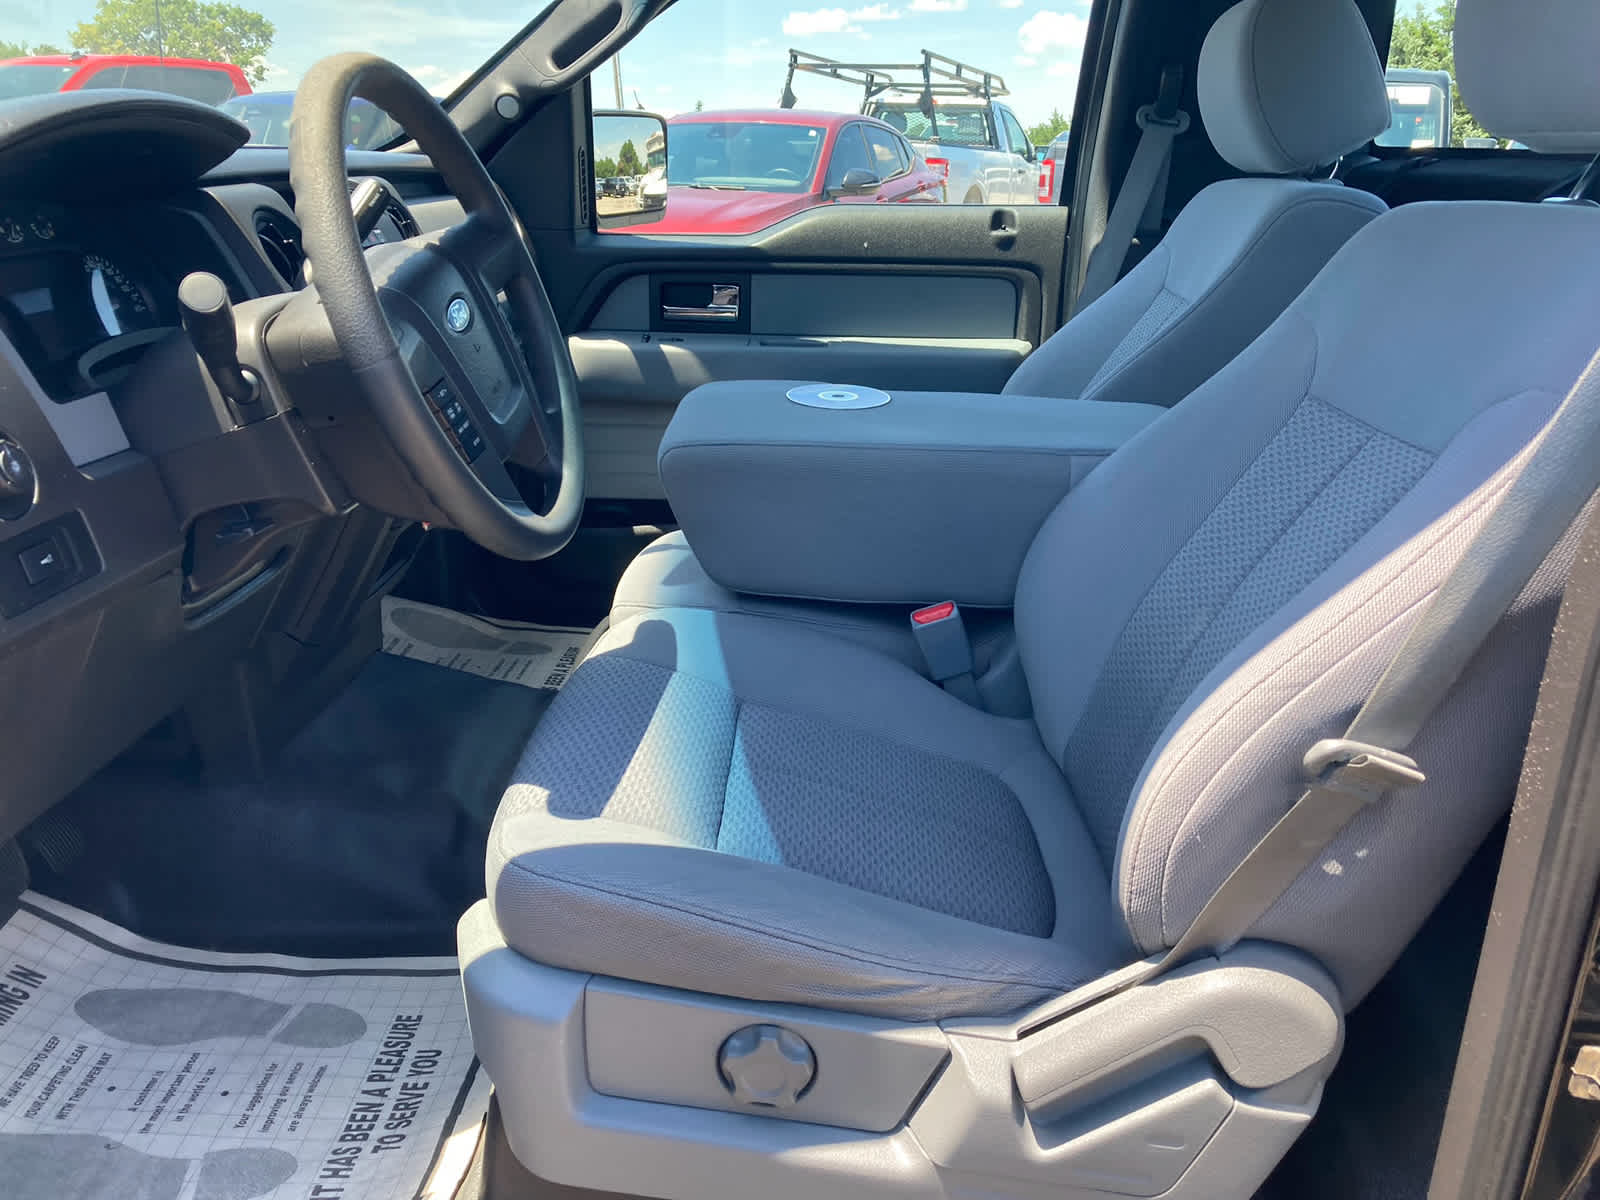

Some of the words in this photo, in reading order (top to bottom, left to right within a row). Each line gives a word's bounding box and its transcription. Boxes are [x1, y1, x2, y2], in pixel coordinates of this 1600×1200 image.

[6, 964, 47, 989] IN
[366, 1014, 424, 1083] PLEASURE
[406, 1049, 442, 1078] YOU
[7, 1081, 26, 1098] HAVE
[34, 1053, 48, 1062] TO
[41, 1035, 60, 1054] KEEP
[25, 1101, 45, 1119] YOUR
[38, 1064, 72, 1102] CARPETING
[65, 1044, 88, 1065] CLEAN
[56, 1103, 76, 1120] WITH
[68, 1087, 88, 1102] THIS
[81, 1066, 104, 1087] PAPER
[99, 1052, 112, 1067] MAT
[233, 1113, 250, 1129] Your
[245, 1072, 274, 1111] suggestions
[280, 1086, 290, 1097] our
[361, 1087, 391, 1098] A
[293, 1095, 313, 1120] always
[384, 1082, 430, 1130] SERVE
[288, 1120, 300, 1132] are
[338, 1102, 384, 1143] BEEN
[371, 1133, 407, 1154] TO
[320, 1146, 362, 1178] HAS
